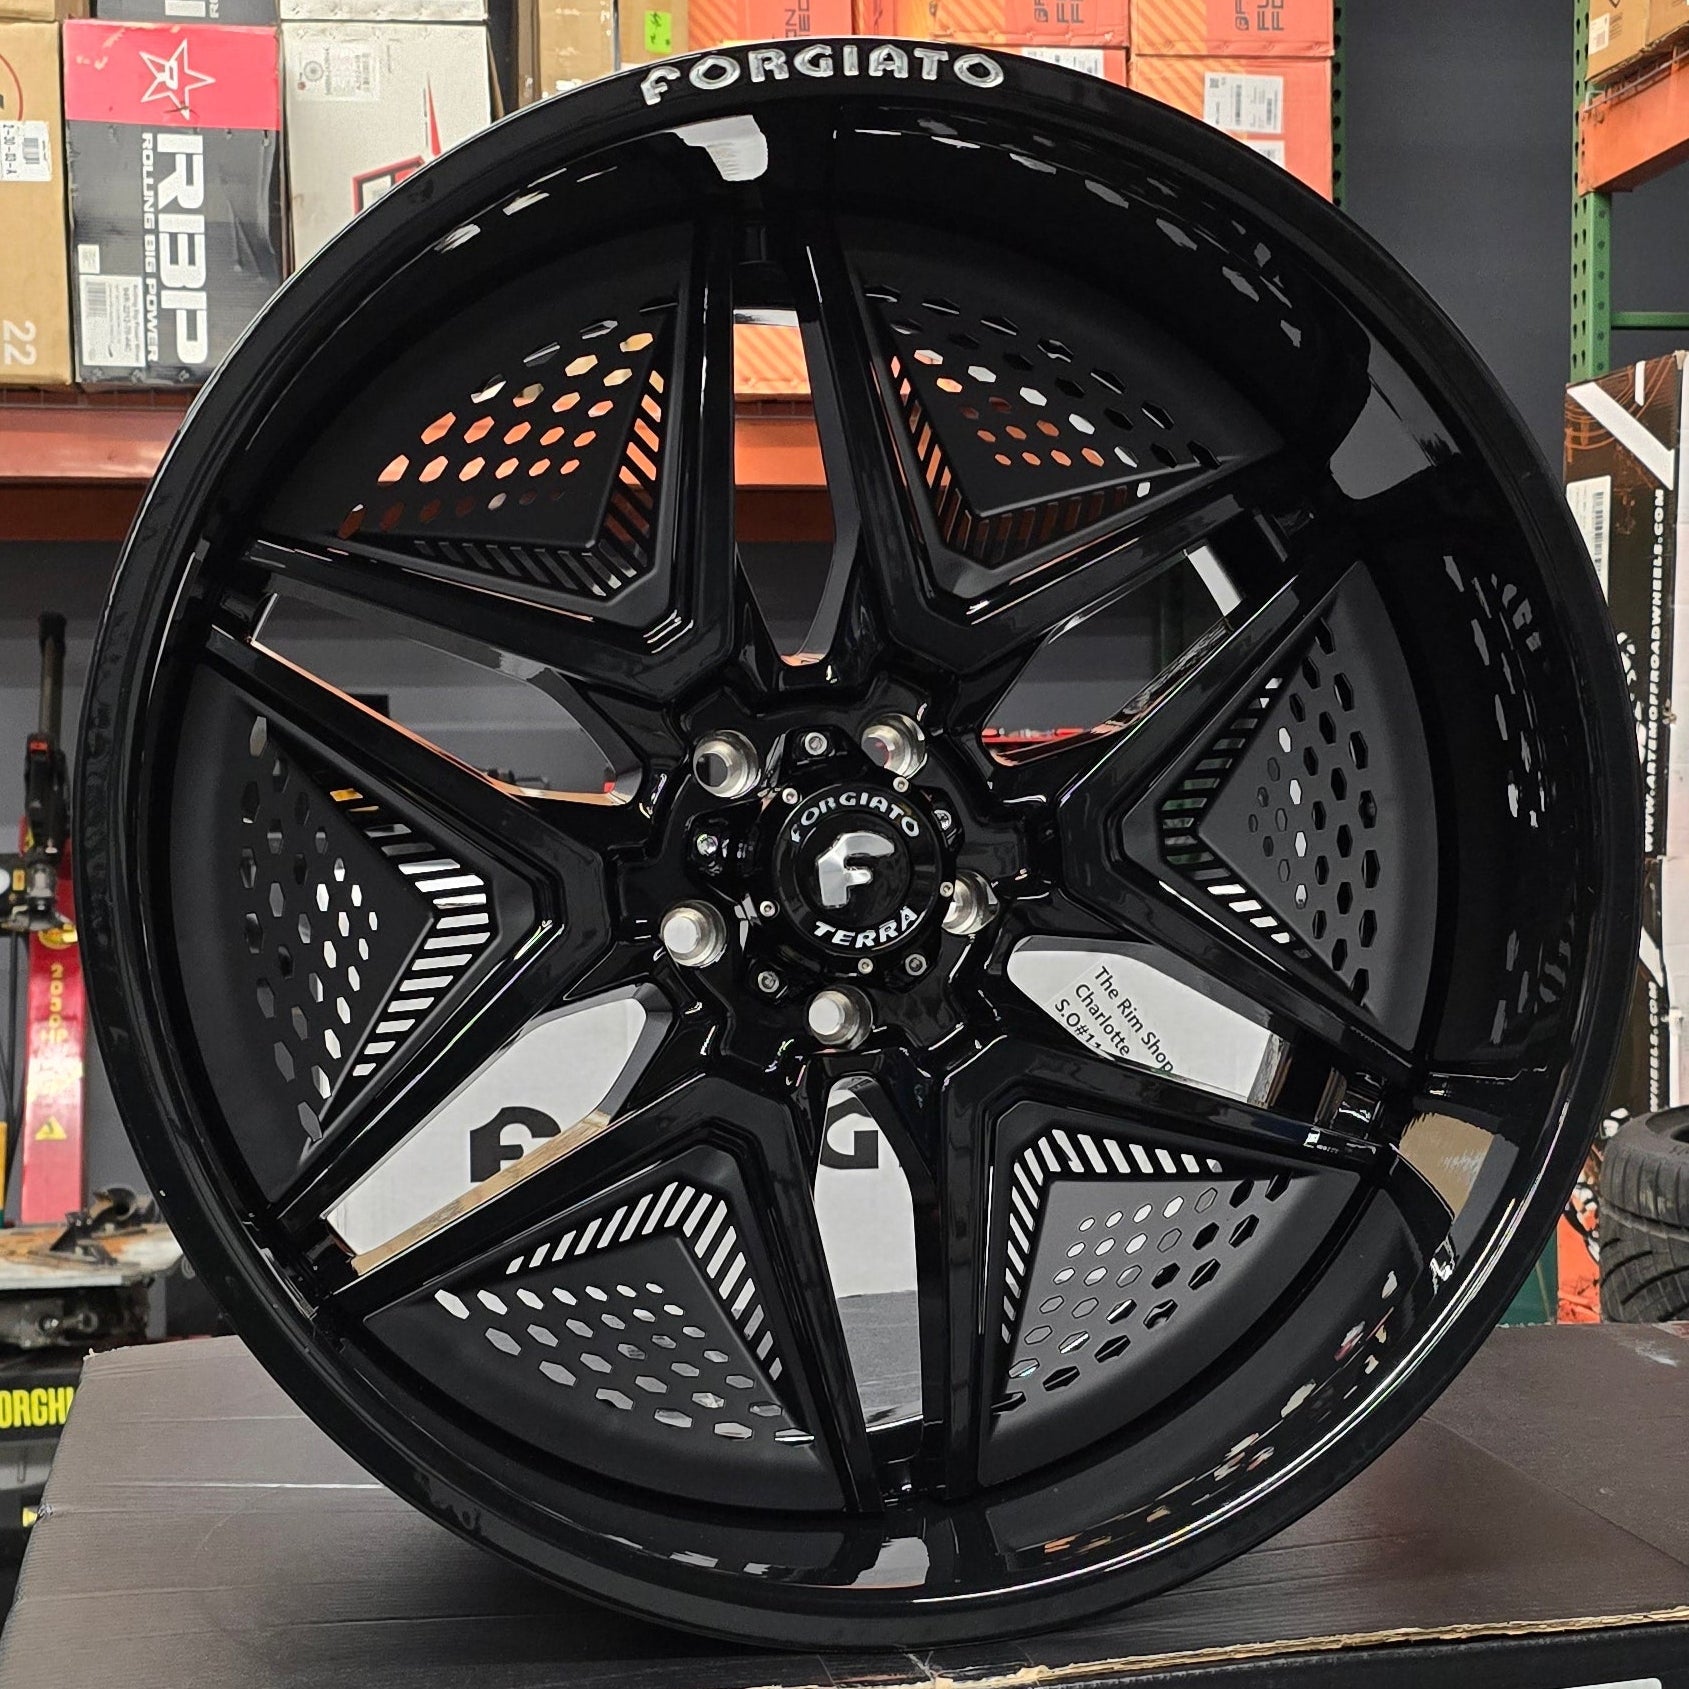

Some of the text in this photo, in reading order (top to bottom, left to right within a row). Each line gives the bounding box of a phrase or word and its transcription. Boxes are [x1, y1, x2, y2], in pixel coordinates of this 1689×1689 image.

[639, 44, 1004, 105] FORGIATO
[142, 132, 159, 362] ROLLING BIG POWER
[157, 133, 208, 364] RBP
[3, 320, 37, 365] 22
[790, 791, 920, 843] FORGIATO
[813, 906, 918, 949] TERRA
[1075, 983, 1131, 1057] Charlotte
[1094, 966, 1174, 1074] The Rim Shop
